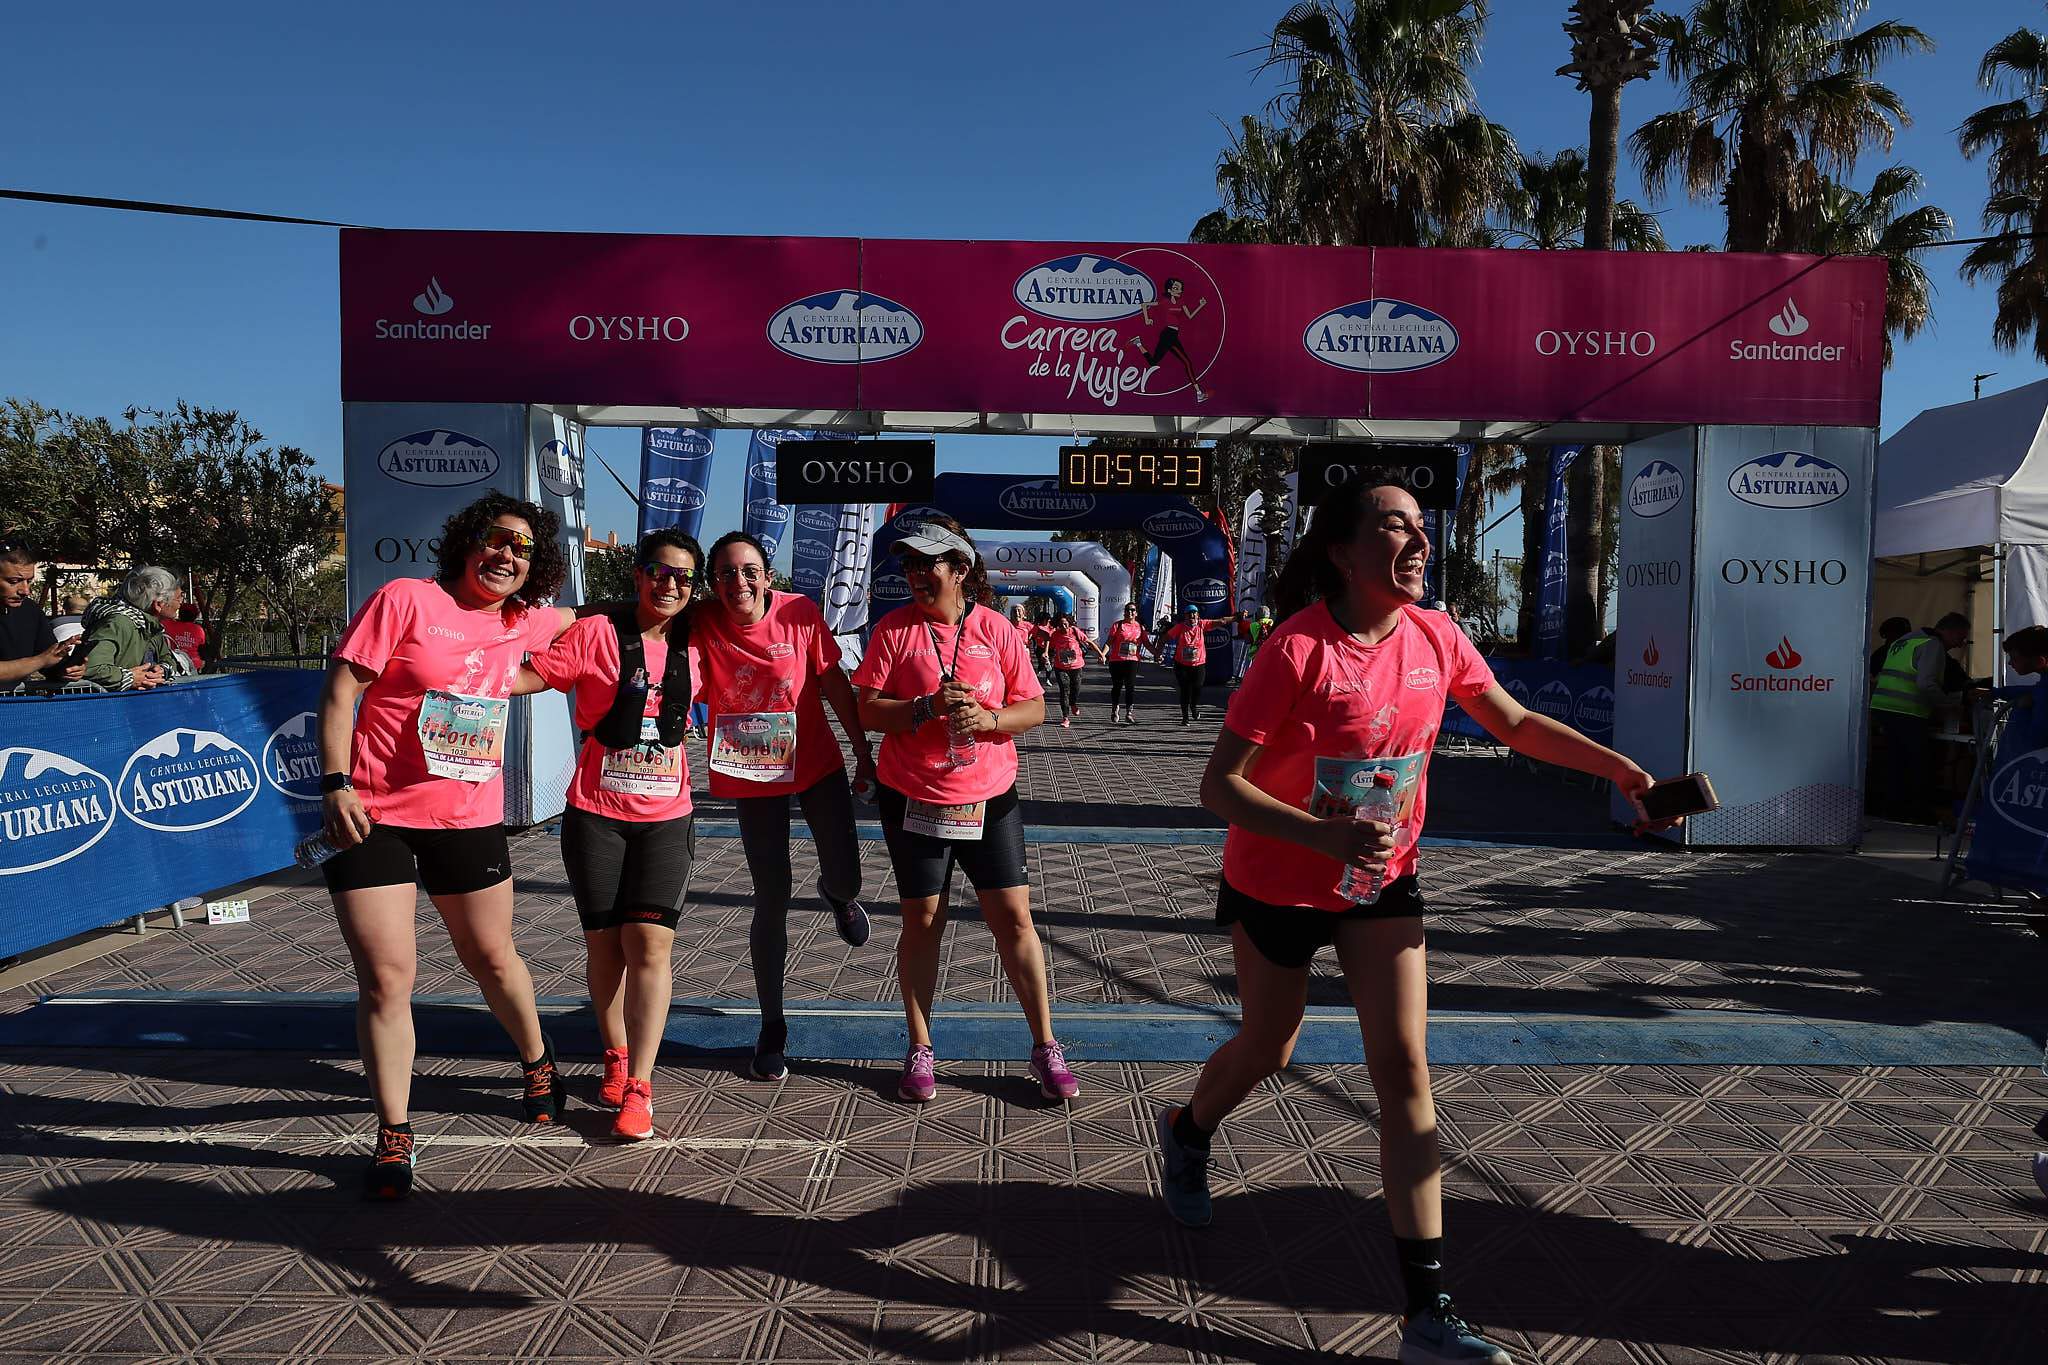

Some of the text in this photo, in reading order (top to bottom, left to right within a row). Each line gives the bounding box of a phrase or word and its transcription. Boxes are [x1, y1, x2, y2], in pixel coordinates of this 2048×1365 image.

[1025, 278, 1145, 305] ASTURIANA
[1047, 276, 1142, 286] CENTRAL LECHERA
[375, 318, 491, 341] Santander
[568, 314, 690, 343] OYSHO
[803, 314, 852, 323] CENTRAL
[1339, 324, 1442, 332] CENTRAL LECHERA
[779, 316, 911, 345] ASTURIANA
[1000, 315, 1118, 353] Carrera
[1315, 325, 1447, 354] ASTURIANA
[1535, 329, 1656, 357] OYSHO
[1730, 340, 1845, 362] Santander
[1028, 349, 1161, 407] de la Mujer
[387, 450, 492, 473] ASTURIANA
[802, 460, 913, 484] OYSHO
[1070, 454, 1201, 486] 00:59:33
[1736, 473, 1840, 495] ASTURIANA
[1006, 491, 1089, 510] ASTURIANA
[1631, 485, 1680, 507] ASTURIANA
[374, 537, 441, 564] OYS
[996, 546, 1073, 564] OYSHO
[1626, 560, 1681, 588] OYSHO
[1721, 558, 1847, 586] OYSHO
[427, 625, 465, 641] OYSHO
[1627, 668, 1673, 689] Santander
[1730, 673, 1834, 692] Santander
[286, 741, 318, 753] CENTRA
[633, 751, 663, 766] 06
[150, 754, 242, 777] CENTRAL LECHERA
[34, 778, 97, 798] LECHERA
[132, 767, 254, 814] ASTURIANA
